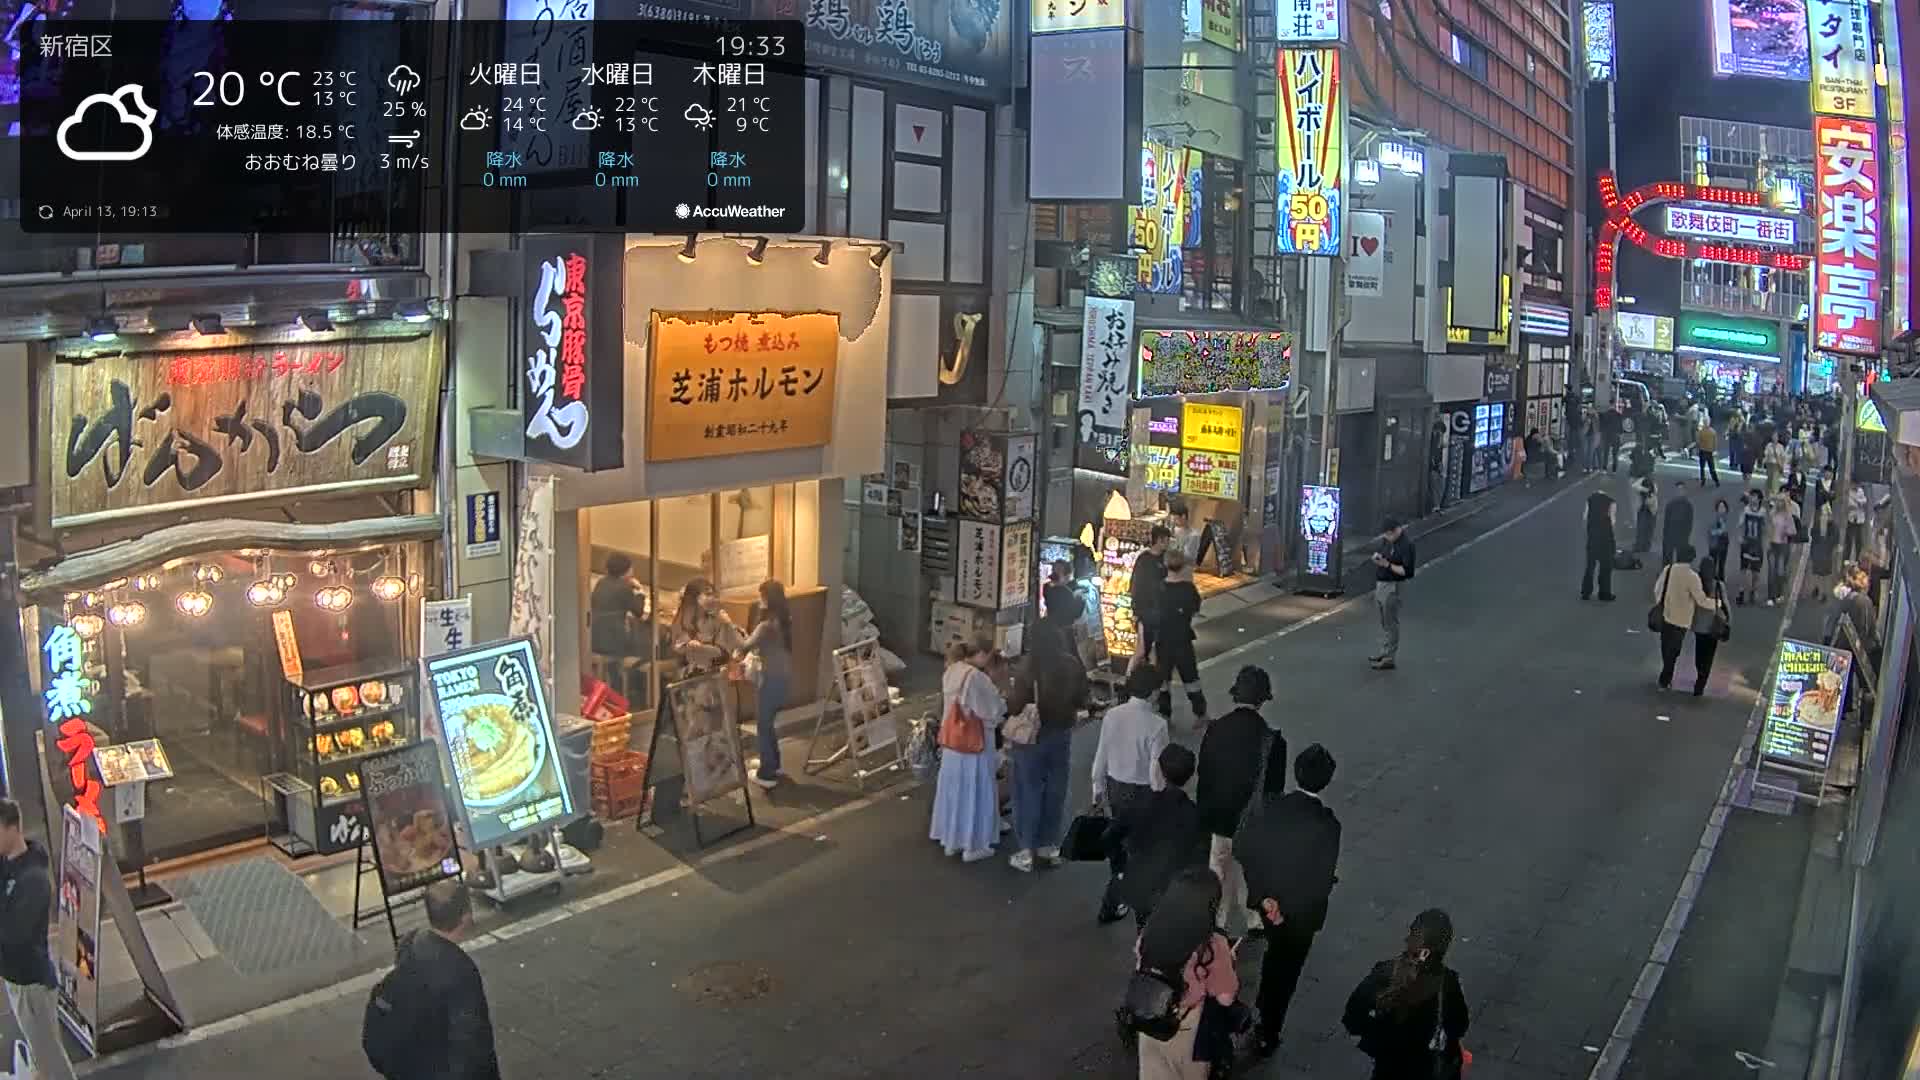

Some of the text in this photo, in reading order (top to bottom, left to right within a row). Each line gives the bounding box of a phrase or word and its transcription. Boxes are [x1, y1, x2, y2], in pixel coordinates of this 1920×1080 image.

[1833, 96, 1856, 110] 3F
[1296, 51, 1325, 190] ハイボール
[1289, 195, 1328, 221] 50
[1294, 222, 1321, 251] 円
[1671, 209, 1791, 241] 歌舞伎町一番街
[1820, 124, 1877, 329] 安楽亭
[1351, 235, 1361, 257] I
[561, 252, 587, 400] 東京豚骨
[703, 330, 749, 354] もつ焼
[1097, 308, 1129, 415] お好み焼き
[669, 365, 824, 406] 芝浦ホルモン
[433, 665, 478, 688] TOKYO
